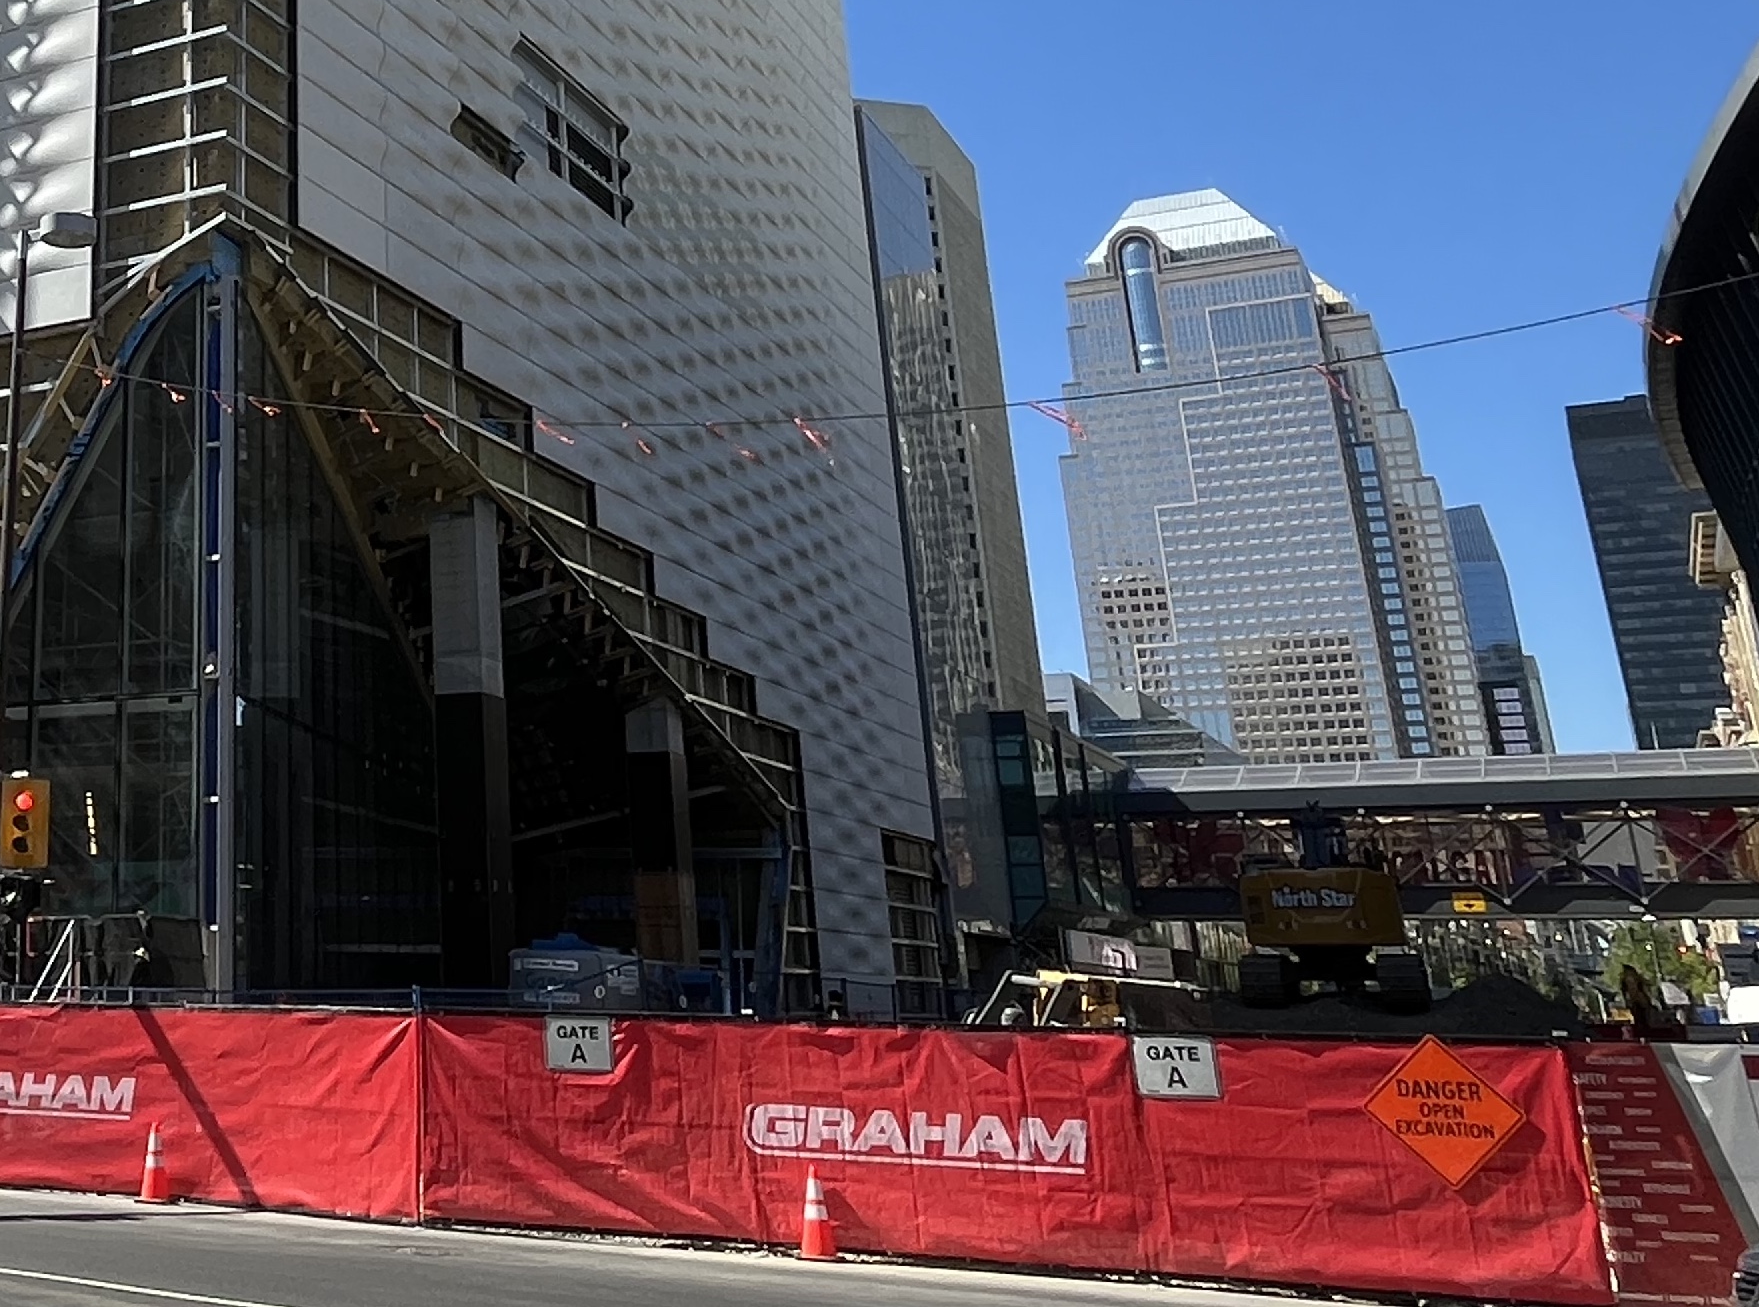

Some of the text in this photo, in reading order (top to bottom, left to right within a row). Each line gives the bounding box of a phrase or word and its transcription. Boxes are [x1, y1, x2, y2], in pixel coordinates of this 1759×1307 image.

[1271, 886, 1356, 908] North Star
[556, 1025, 599, 1041] GATE
[571, 1043, 587, 1064] A
[1146, 1045, 1201, 1063] GATE
[1167, 1066, 1189, 1089] A
[1395, 1078, 1483, 1103] DANGER
[1419, 1101, 1465, 1120] OPEN
[751, 1103, 1087, 1165] GRAHAM
[1395, 1119, 1496, 1140] EXCAVATION
